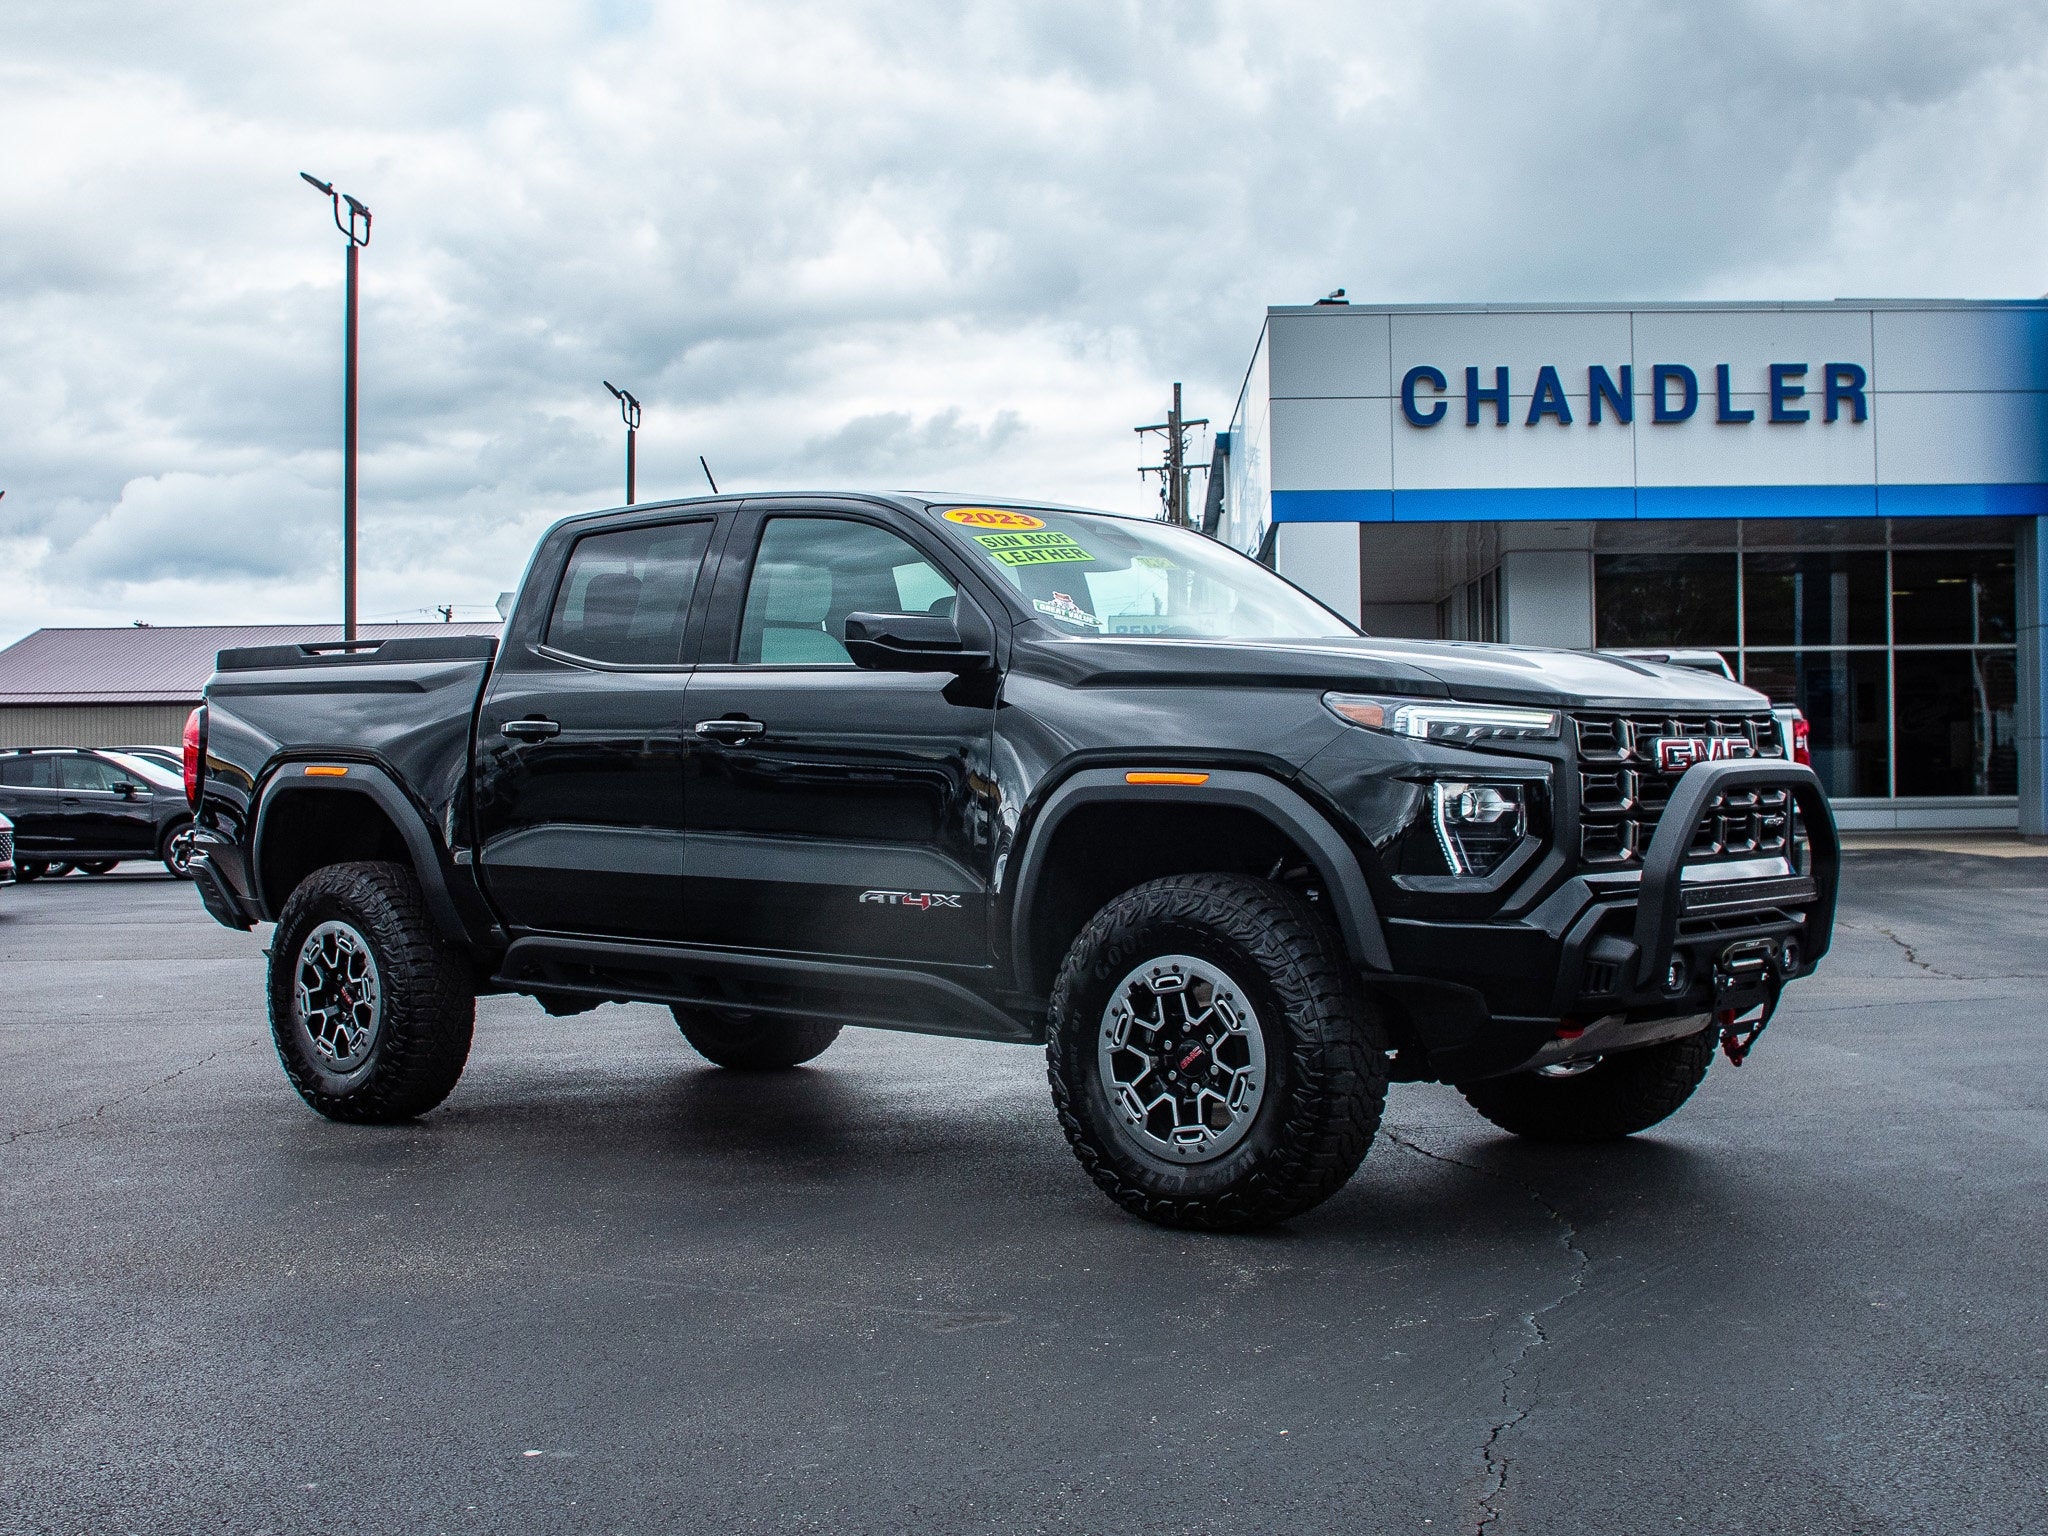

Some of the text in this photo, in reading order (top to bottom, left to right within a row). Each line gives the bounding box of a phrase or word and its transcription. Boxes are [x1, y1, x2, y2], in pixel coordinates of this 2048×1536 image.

[1400, 363, 1868, 428] CHANDLER
[956, 512, 1036, 527] 2023
[981, 533, 1071, 549] SUN ROOF
[997, 548, 1091, 564] LEATHER
[860, 890, 962, 911] AT4X
[1179, 1045, 1203, 1070] GMC
